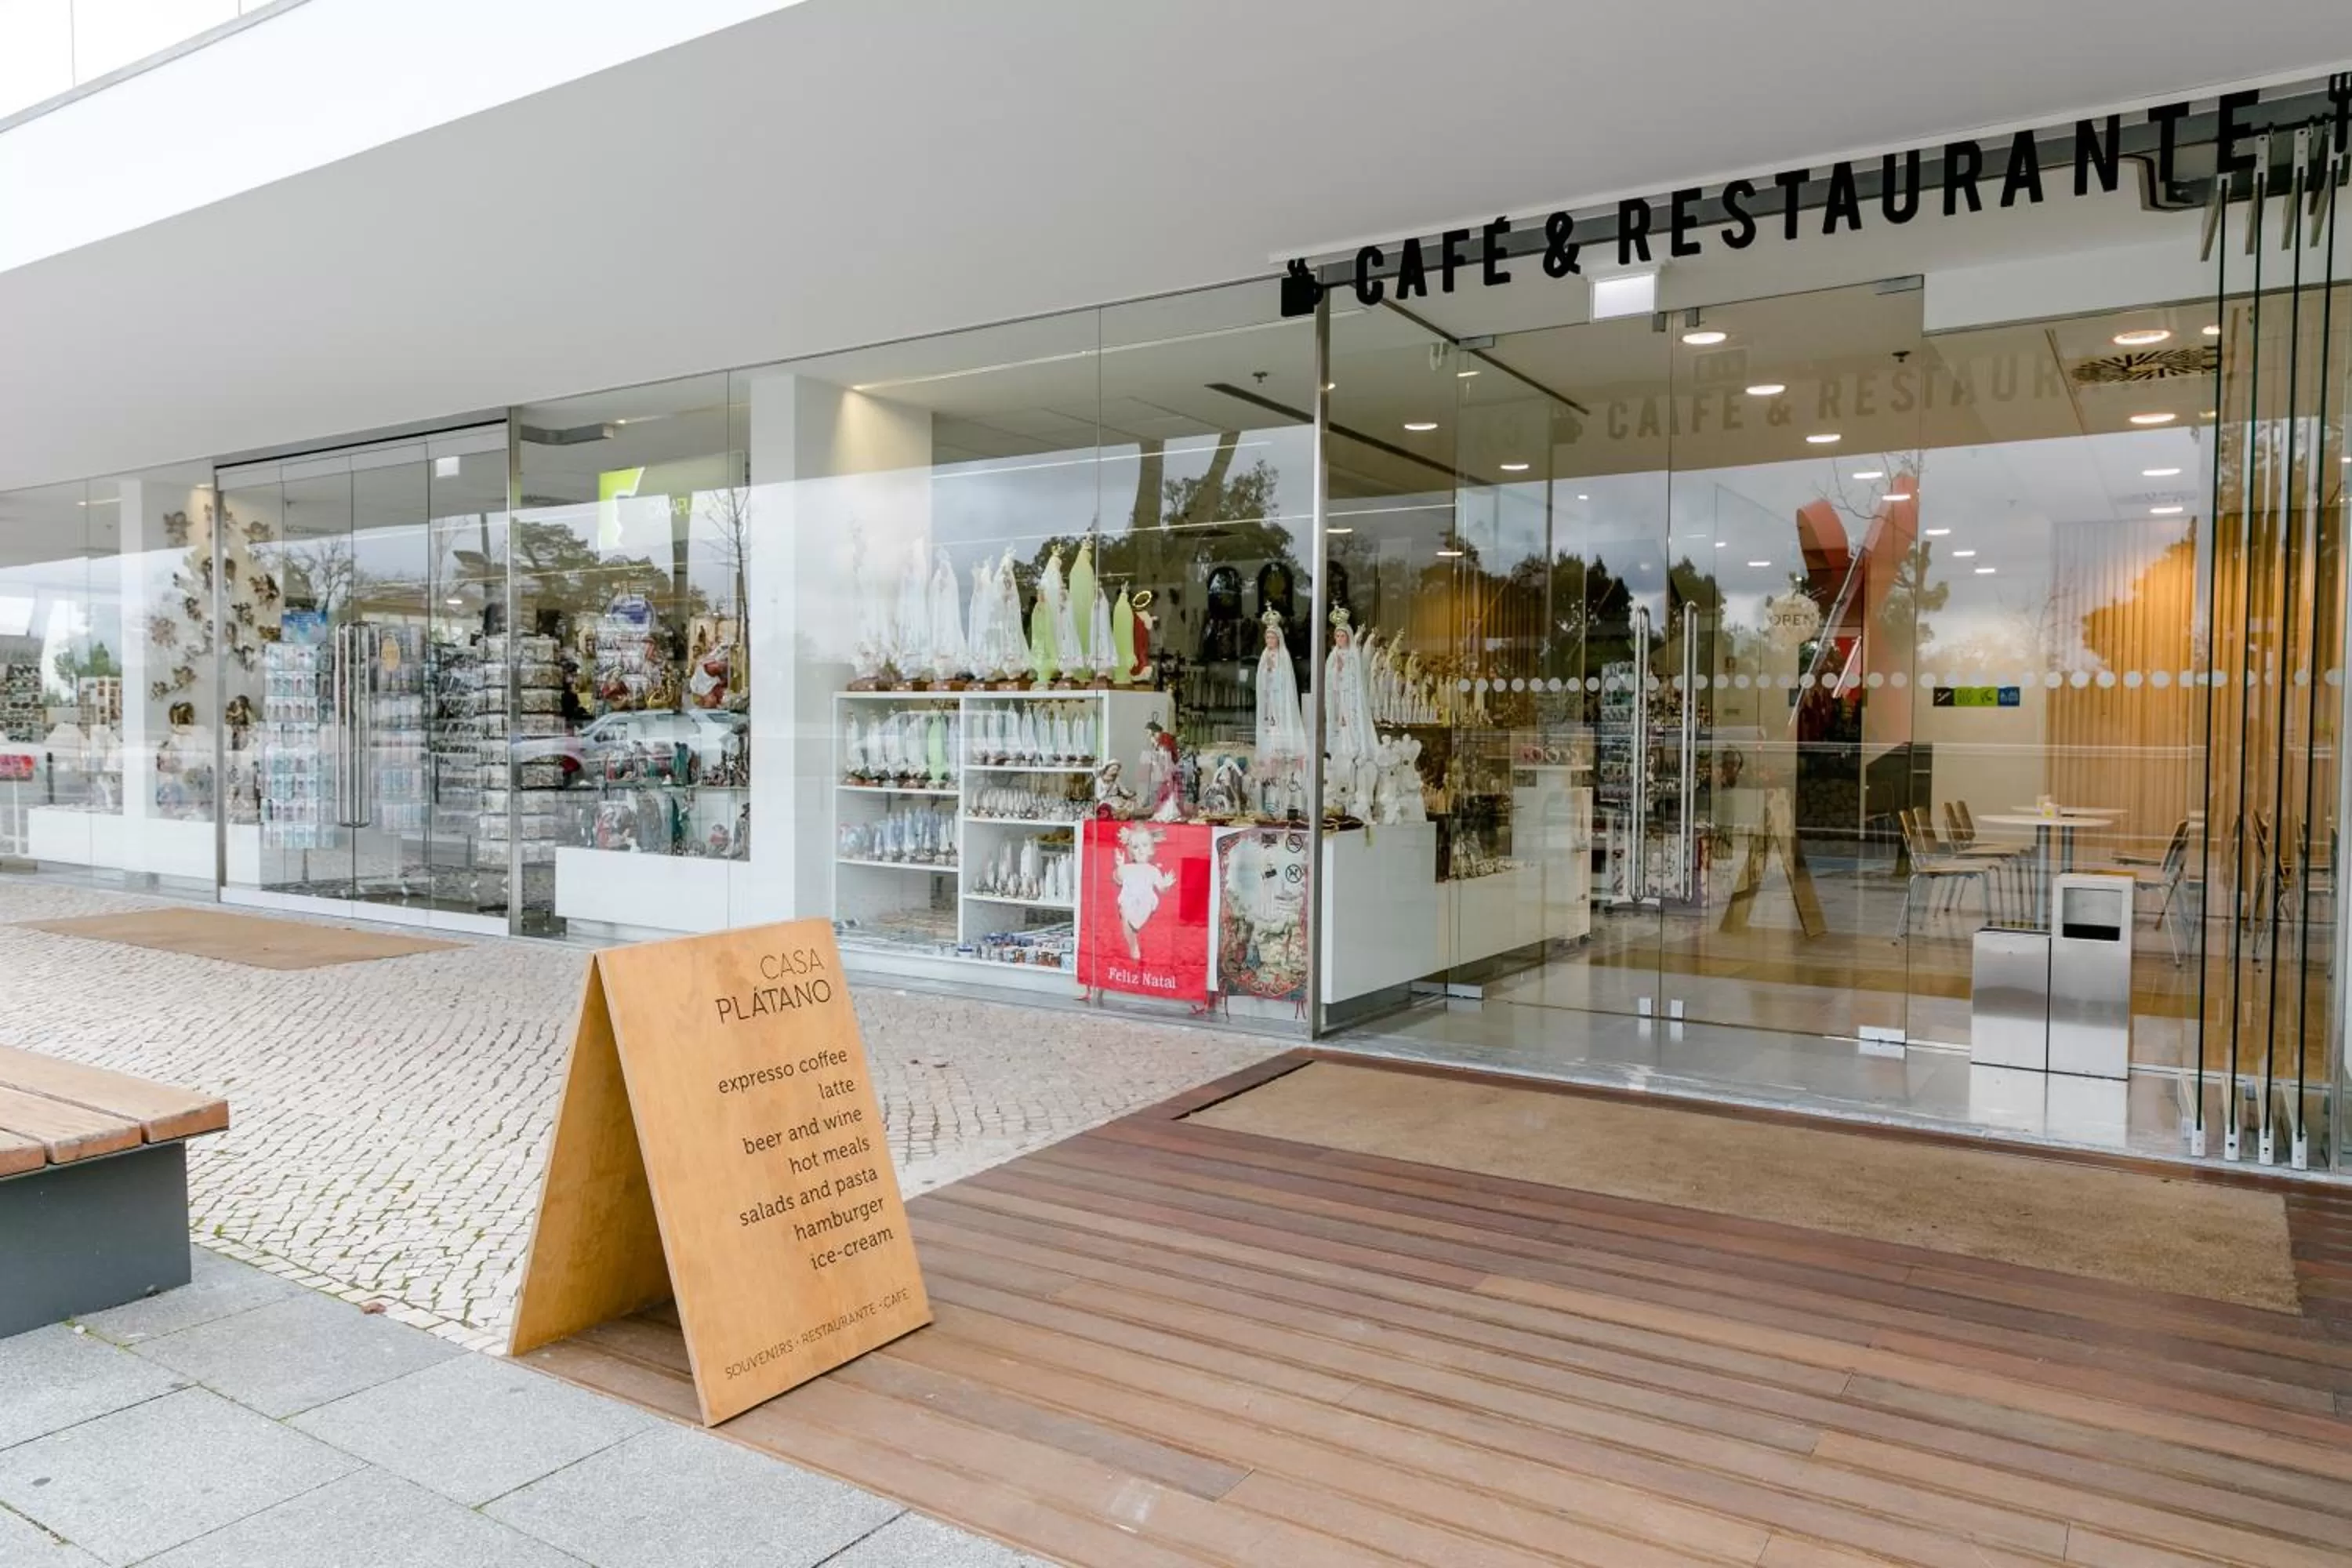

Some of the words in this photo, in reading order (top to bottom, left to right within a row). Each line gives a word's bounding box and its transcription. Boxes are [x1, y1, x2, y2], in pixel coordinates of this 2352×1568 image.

[1356, 216, 1512, 306] CAFÉ
[1543, 211, 1581, 278] &
[1617, 89, 2259, 265] RESTAURANTE
[760, 947, 825, 980] CASA
[1108, 966, 1139, 985] Feliz
[1142, 971, 1177, 989] Natal
[714, 979, 832, 1025] PLÁTANO
[717, 1063, 795, 1094] expresso
[799, 1049, 848, 1074] coffee
[818, 1078, 856, 1100] latte
[742, 1131, 783, 1156] beer
[787, 1116, 820, 1142] and
[823, 1108, 862, 1131] wine
[788, 1151, 820, 1175] hot
[822, 1136, 871, 1165] meals
[739, 1194, 796, 1227] salads
[800, 1179, 832, 1206] and
[834, 1167, 879, 1198] pasta
[793, 1196, 884, 1242] hamburger
[809, 1227, 895, 1271] ice-cream
[724, 1338, 795, 1380] SOUVENIRS
[801, 1303, 877, 1345] RESTAURANTE
